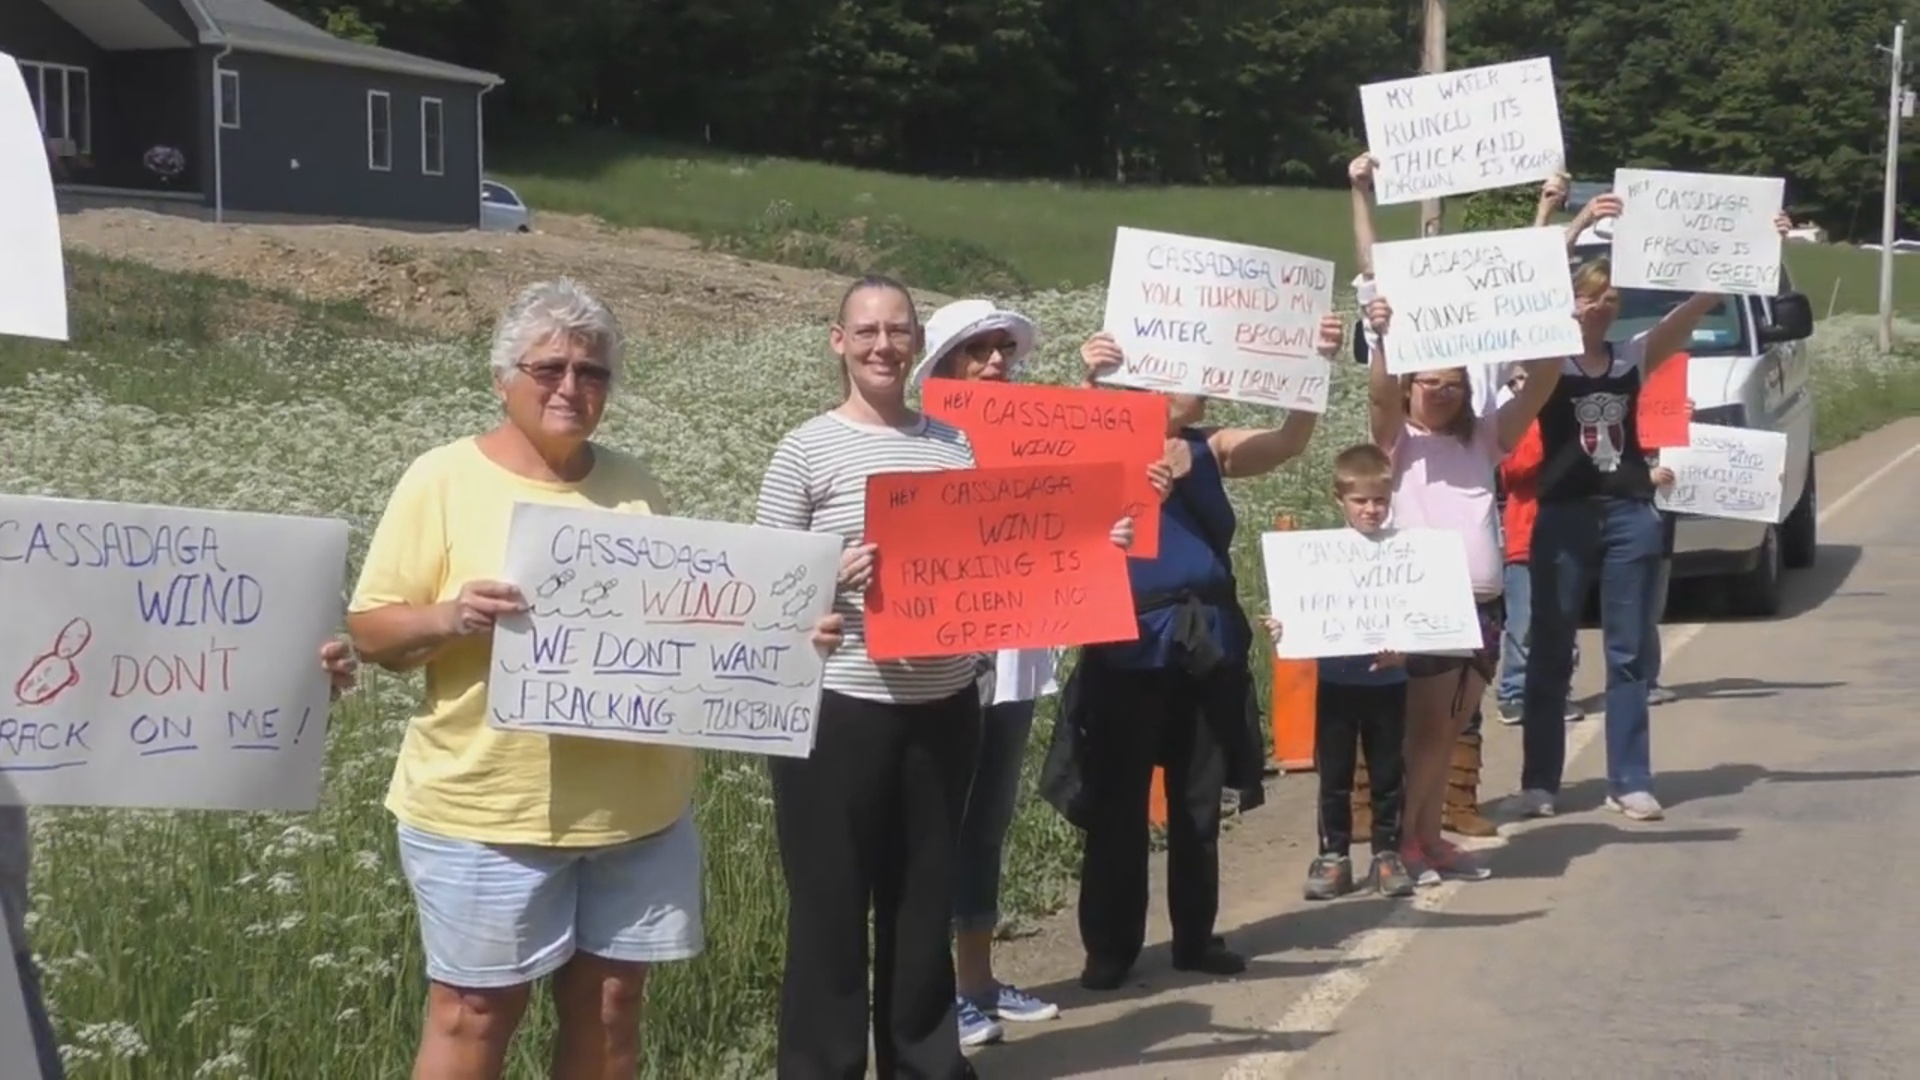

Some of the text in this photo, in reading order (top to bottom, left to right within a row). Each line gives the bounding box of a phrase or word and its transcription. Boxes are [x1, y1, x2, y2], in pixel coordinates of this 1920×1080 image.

[1385, 86, 1414, 109] MY
[1438, 70, 1500, 100] WATER
[1384, 109, 1471, 147] RUINED
[1390, 130, 1525, 175] THICK AND
[1384, 172, 1454, 200] BROWN
[1147, 245, 1327, 291] CASSADAGA WIND
[1730, 242, 1751, 256] IS
[1466, 259, 1535, 291] WIND
[1646, 261, 1691, 279] NOT
[1142, 281, 1315, 314] YOU TURNED MY
[1134, 317, 1316, 348] WATER BROWN
[1126, 354, 1189, 380] WOULD
[1202, 366, 1235, 386] YOU
[1239, 369, 1291, 392] DRINK
[943, 390, 1135, 433] HEY CASSADAGA
[1010, 439, 1077, 457] WIND
[889, 475, 1074, 508] HEY CASSADAGA
[0, 519, 226, 572] CASSADAGA
[978, 511, 1065, 547] WIND
[550, 524, 735, 580] CASSADAGA
[902, 549, 1081, 587] FRACKING IS
[137, 572, 262, 627] WIND
[640, 577, 757, 619] WIND
[891, 598, 936, 620] NOT
[955, 590, 1023, 615] CLEAN
[531, 624, 791, 672] WE DONT WANT
[513, 679, 810, 734] FRACKING TURBINES
[130, 714, 192, 745] ON
